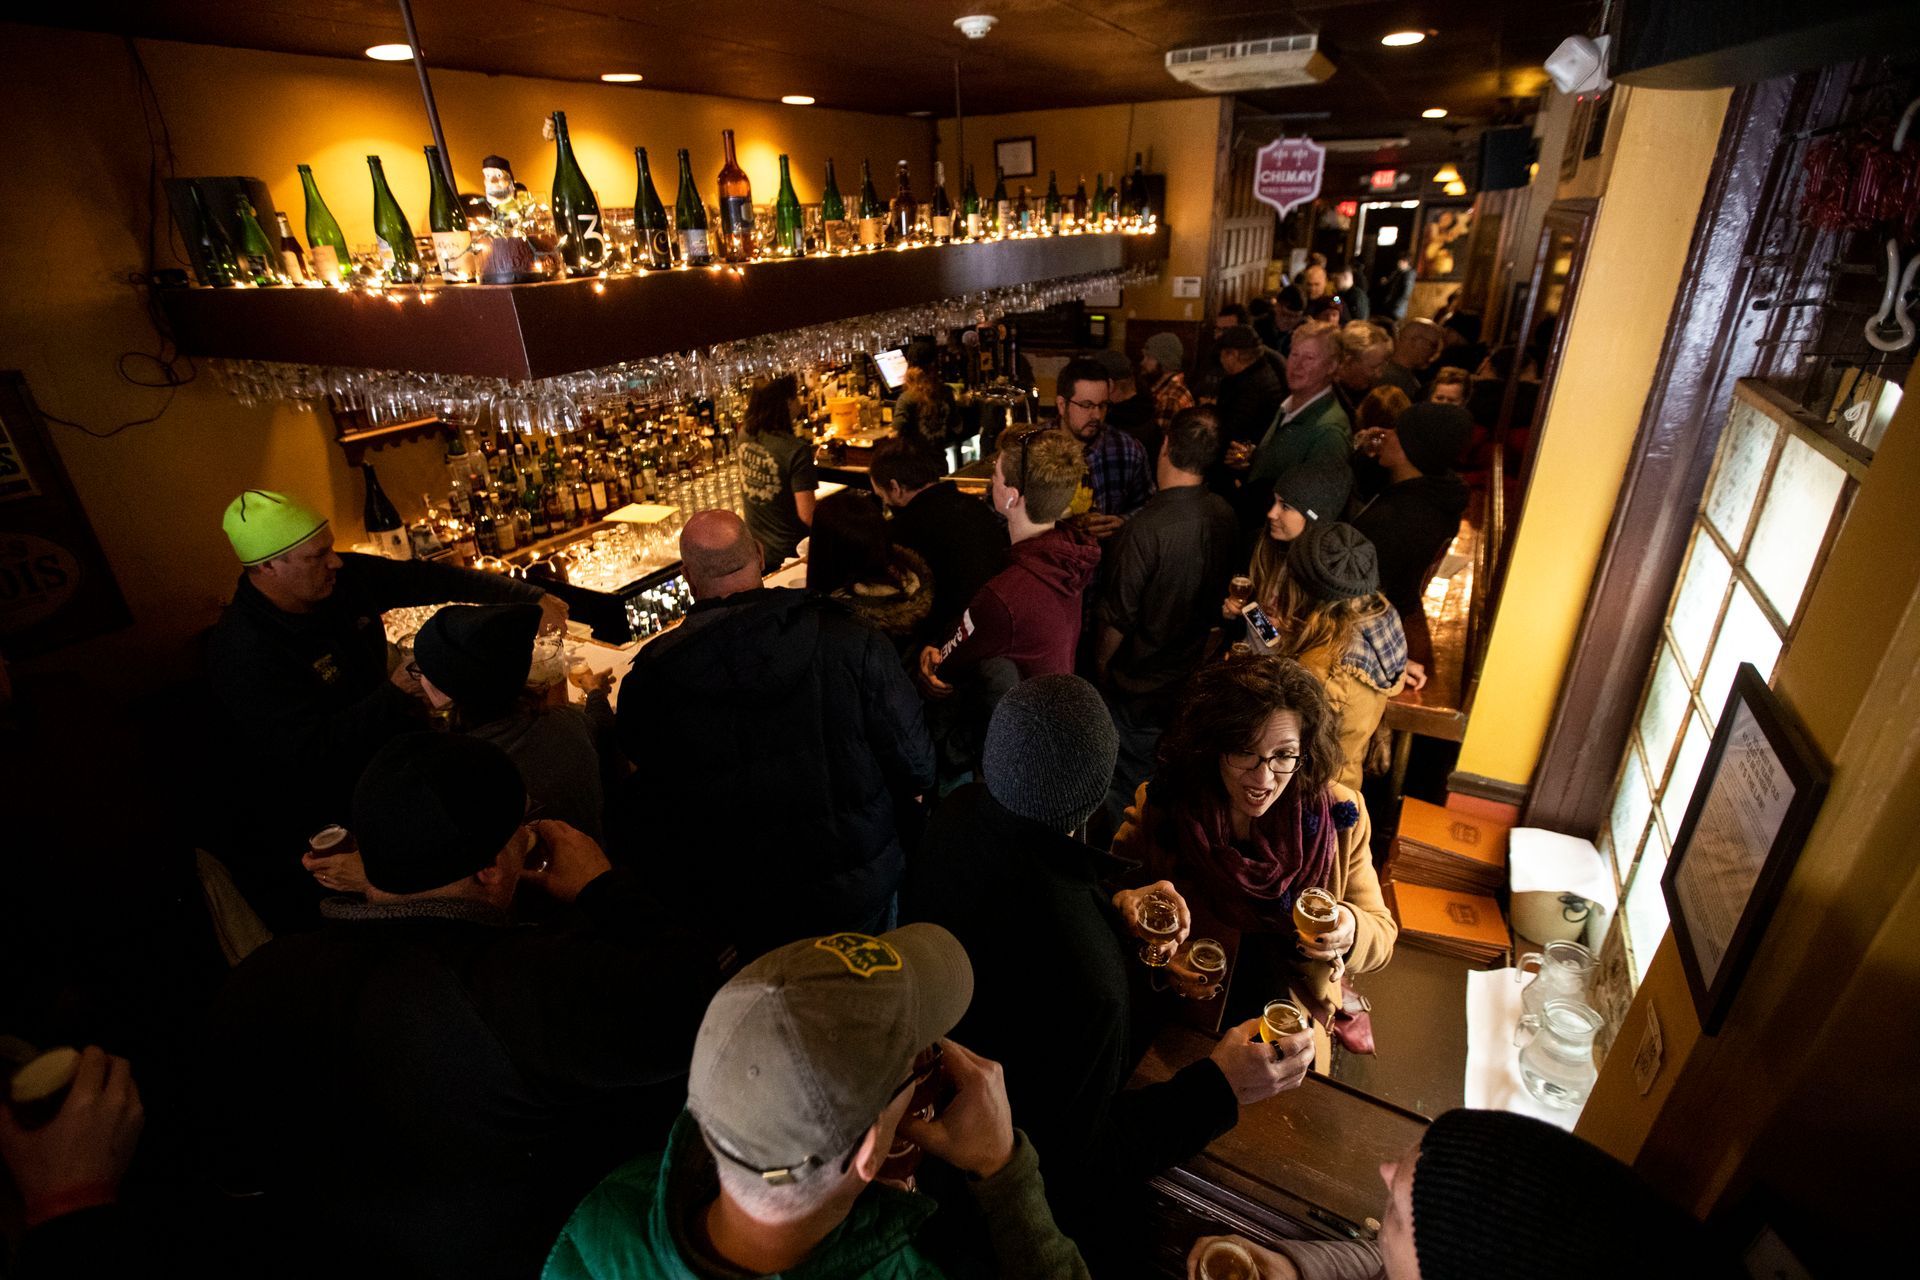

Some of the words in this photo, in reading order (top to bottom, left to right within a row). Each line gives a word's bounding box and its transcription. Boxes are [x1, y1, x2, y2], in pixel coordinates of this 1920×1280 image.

[1260, 170, 1317, 183] CHIMAY
[577, 214, 607, 269] 3
[1771, 785, 1779, 801] OLD
